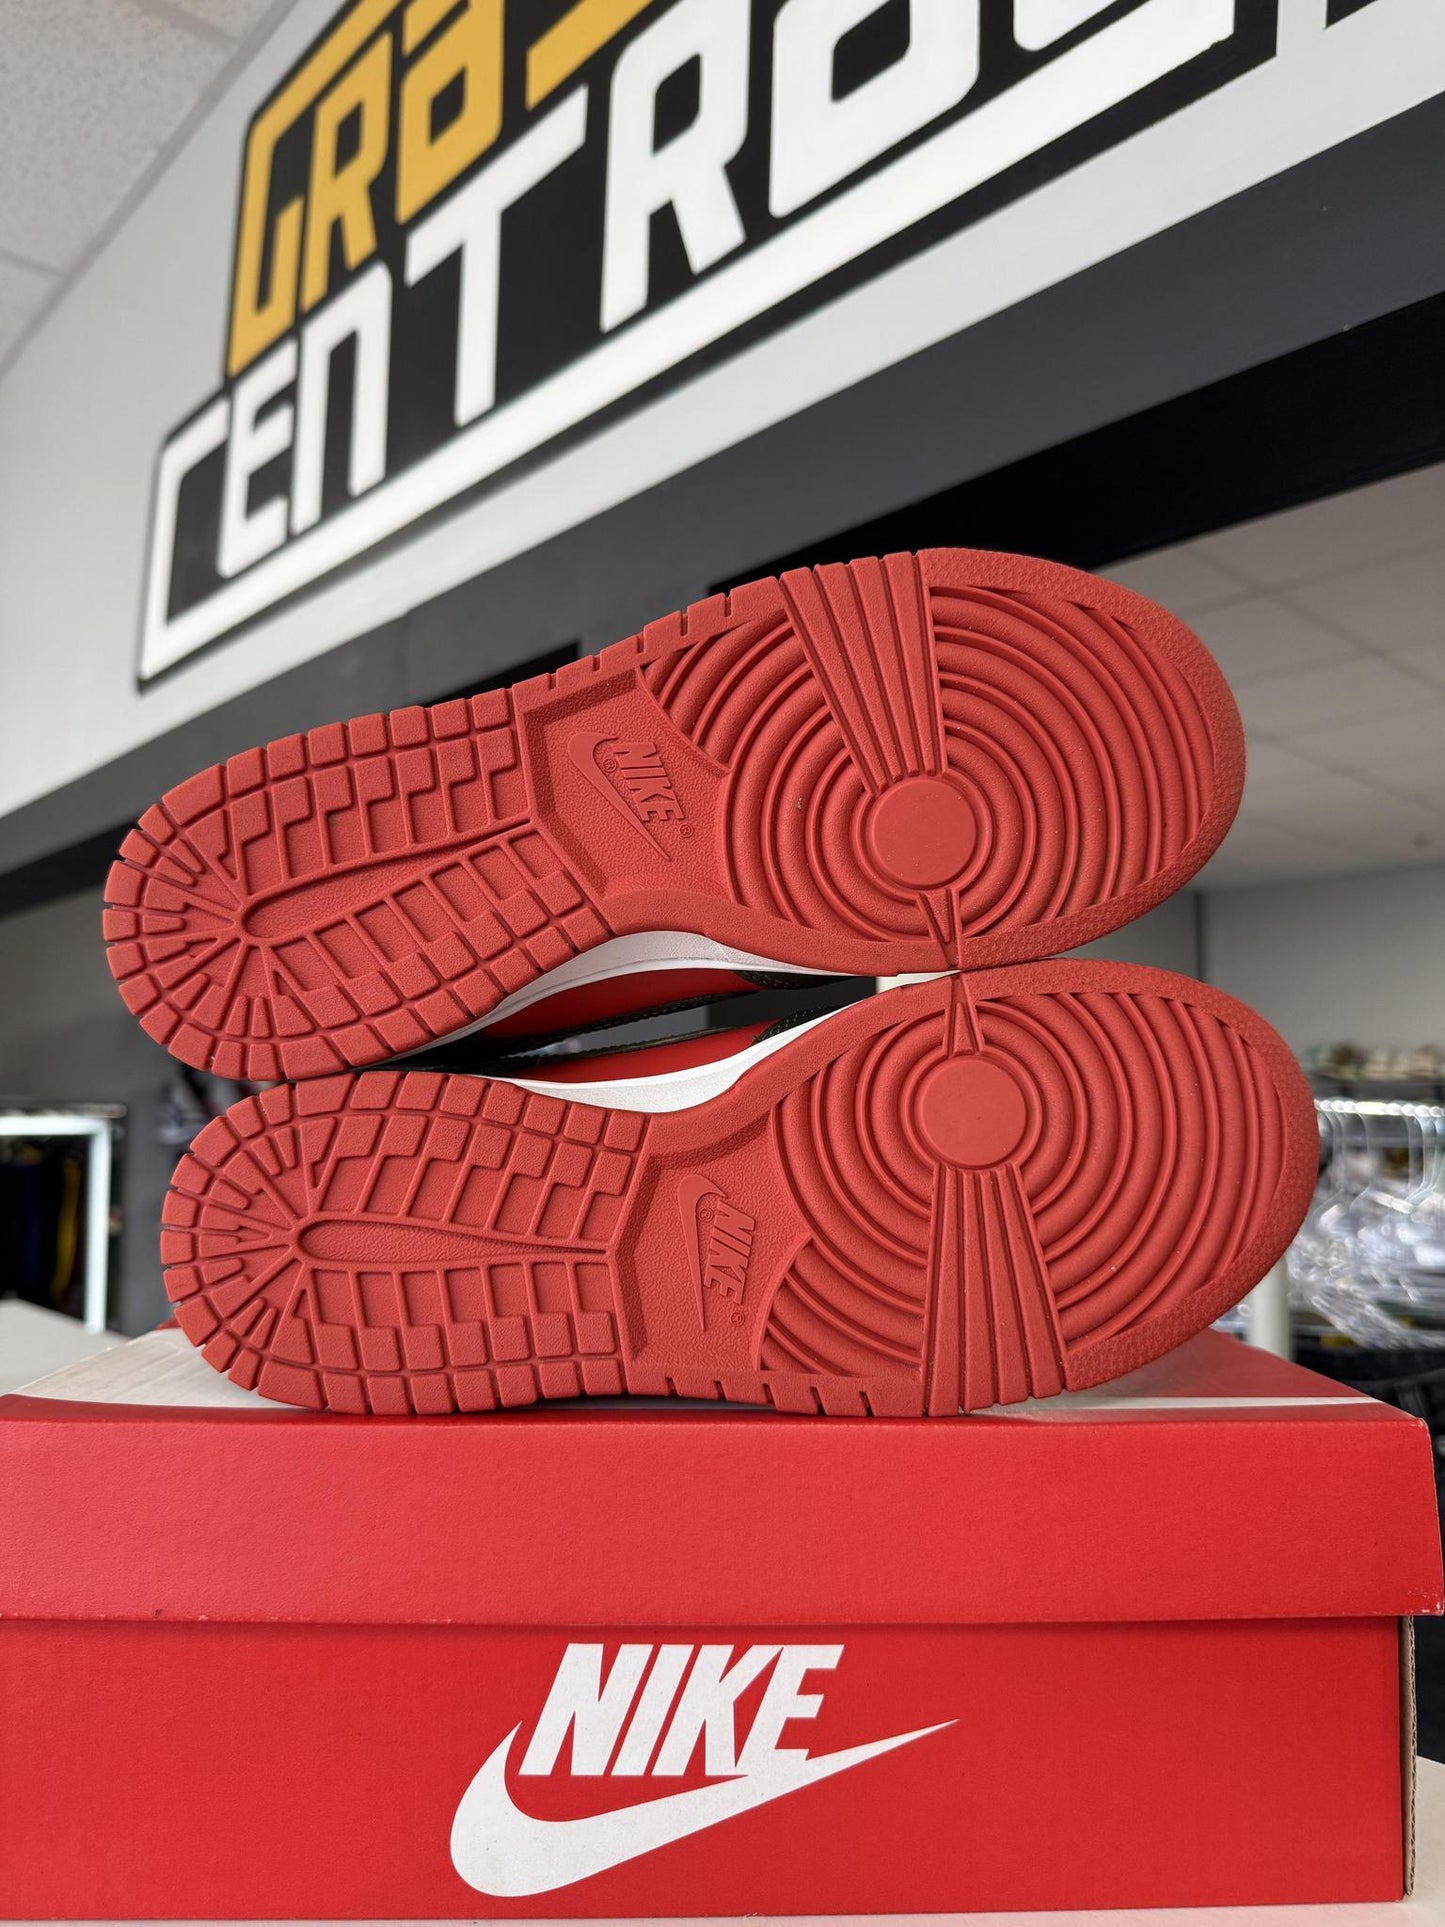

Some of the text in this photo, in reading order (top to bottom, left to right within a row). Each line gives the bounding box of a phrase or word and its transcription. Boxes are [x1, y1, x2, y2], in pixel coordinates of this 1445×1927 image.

[611, 741, 676, 822] NIKE
[703, 1199, 756, 1306] NIKE
[518, 1643, 845, 1776] NIKE
